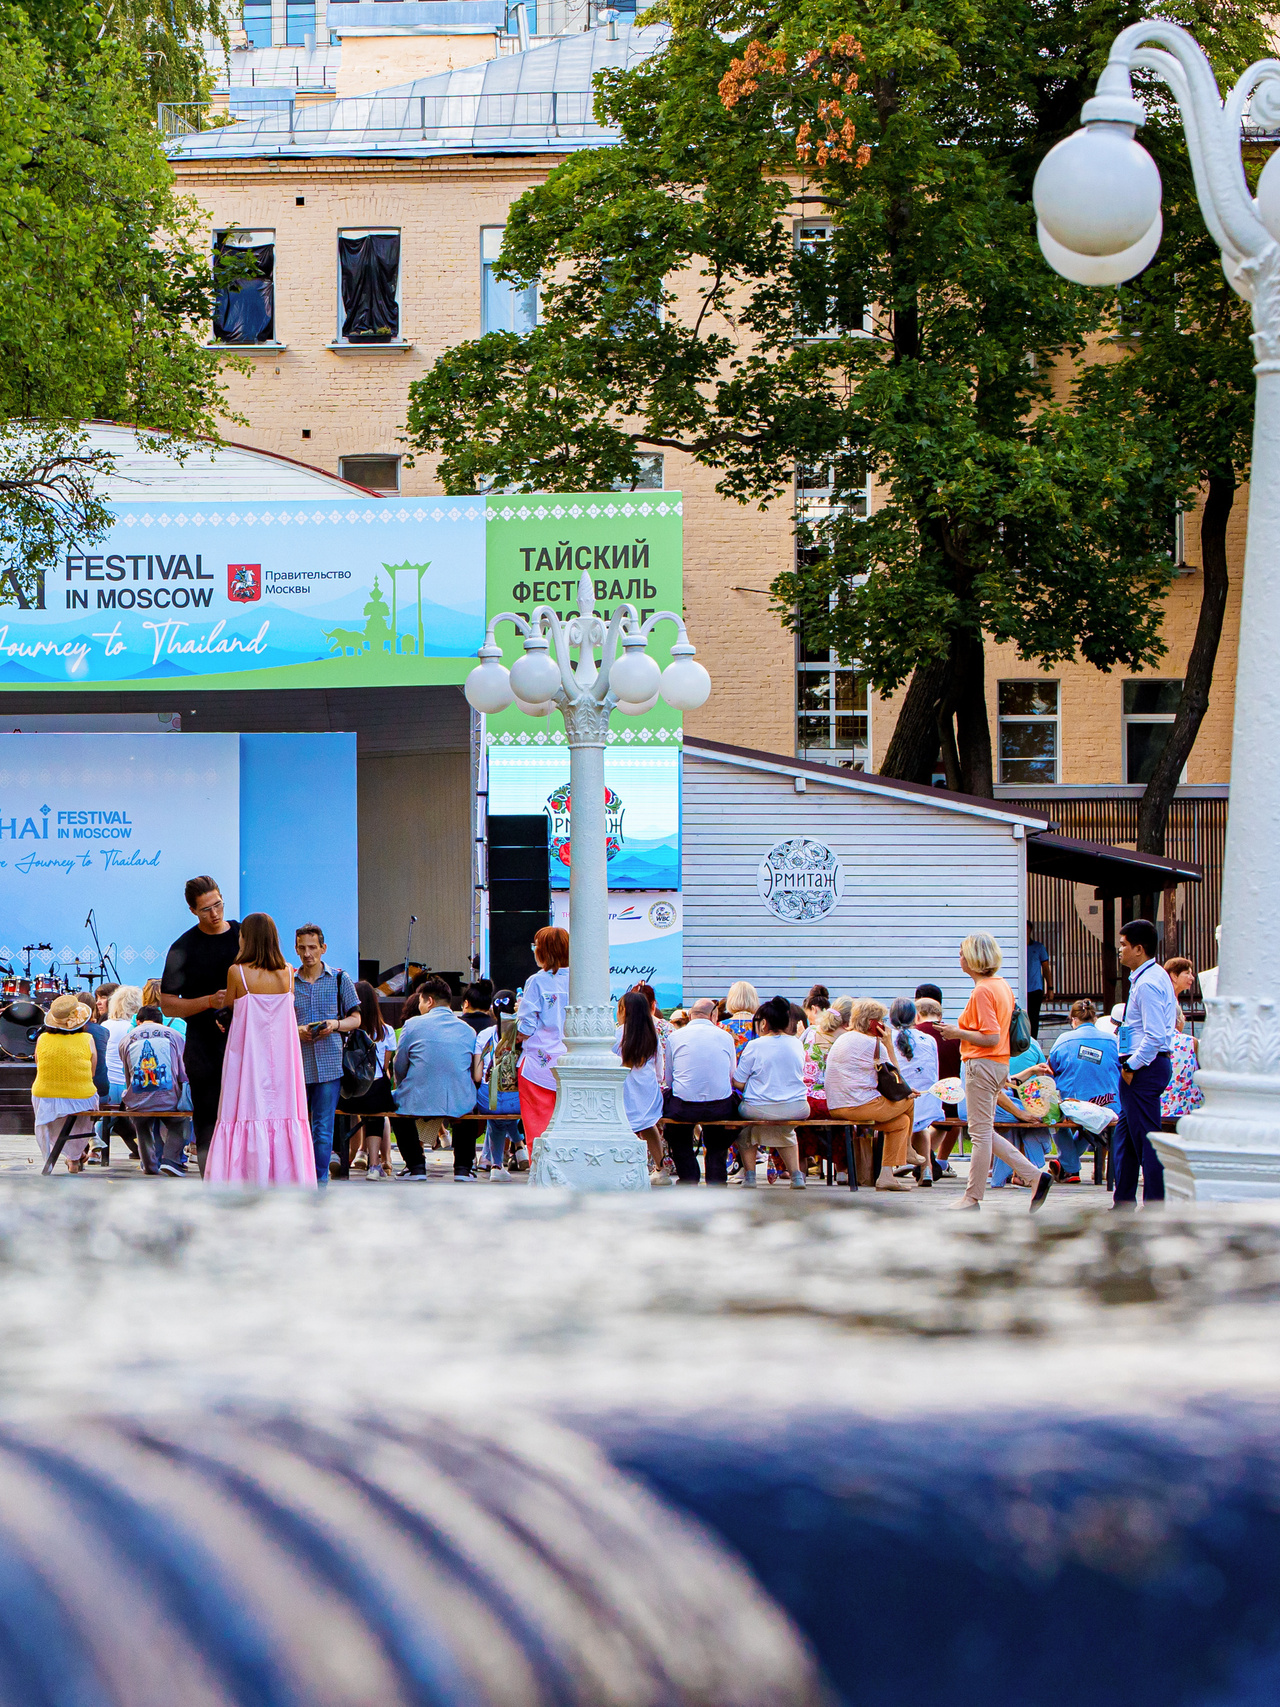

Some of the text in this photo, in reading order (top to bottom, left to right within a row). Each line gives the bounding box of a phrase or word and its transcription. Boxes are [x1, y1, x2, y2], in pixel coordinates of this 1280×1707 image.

[520, 538, 649, 571] ТАЙСКИЙ
[66, 554, 214, 581] FESTIVAL
[265, 569, 352, 582] Правительство
[66, 588, 214, 609] IN MOSCOW
[265, 584, 311, 595] Москвы
[512, 579, 657, 603] ФЕСТВАЛЬ
[92, 620, 128, 657] to
[142, 617, 270, 665] Thailand
[57, 811, 132, 825] FESTIVAL
[57, 828, 132, 839] IN MOSCOW
[14, 851, 76, 875] Journey
[76, 850, 93, 867] to
[99, 848, 162, 871] Thailand
[608, 965, 657, 983] ourney
